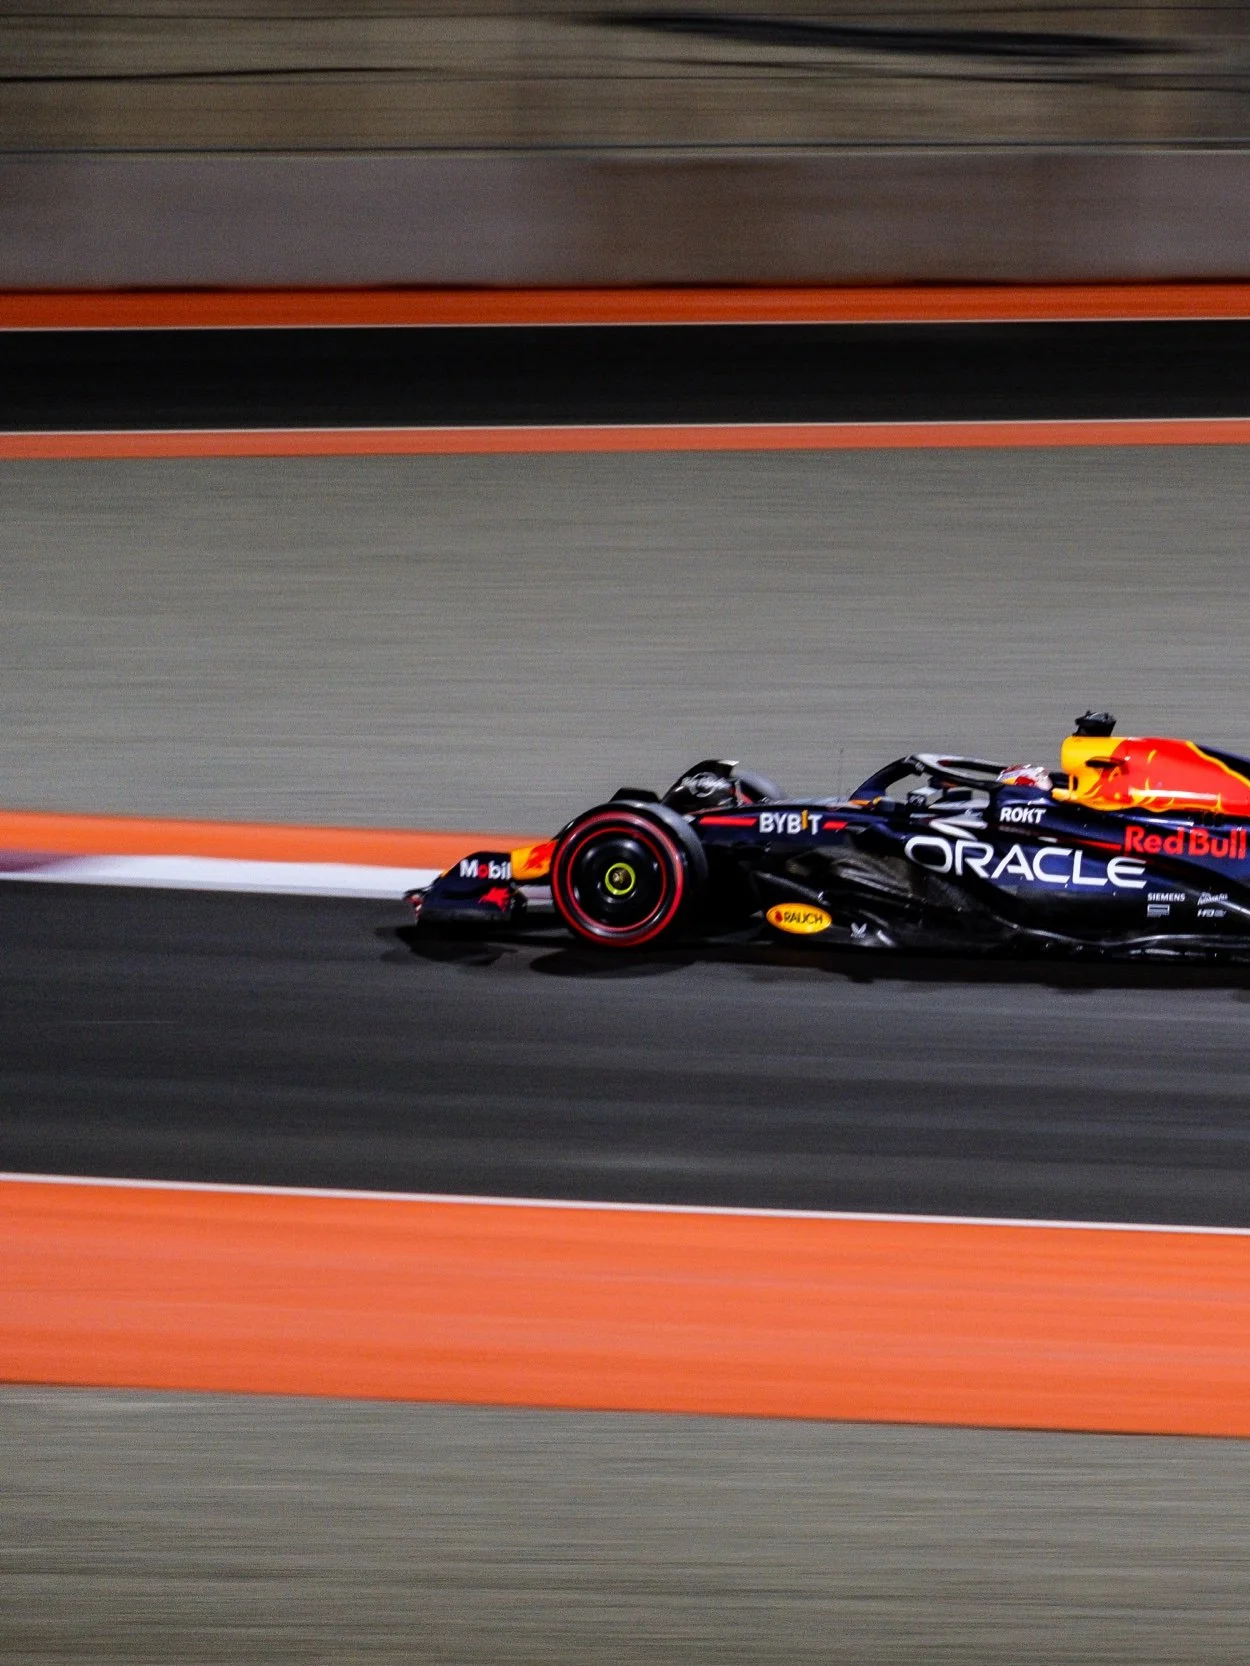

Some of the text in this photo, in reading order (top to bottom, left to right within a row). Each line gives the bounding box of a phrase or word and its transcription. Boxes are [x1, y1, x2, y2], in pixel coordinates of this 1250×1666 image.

[759, 810, 823, 834] BYBIT
[1000, 807, 1047, 823] ROKT
[1124, 825, 1247, 859] Red Bull
[460, 859, 512, 879] Mobil
[904, 835, 1148, 889] ORACLE
[1147, 892, 1186, 902] SIEMENS
[783, 911, 823, 924] RAUCH
